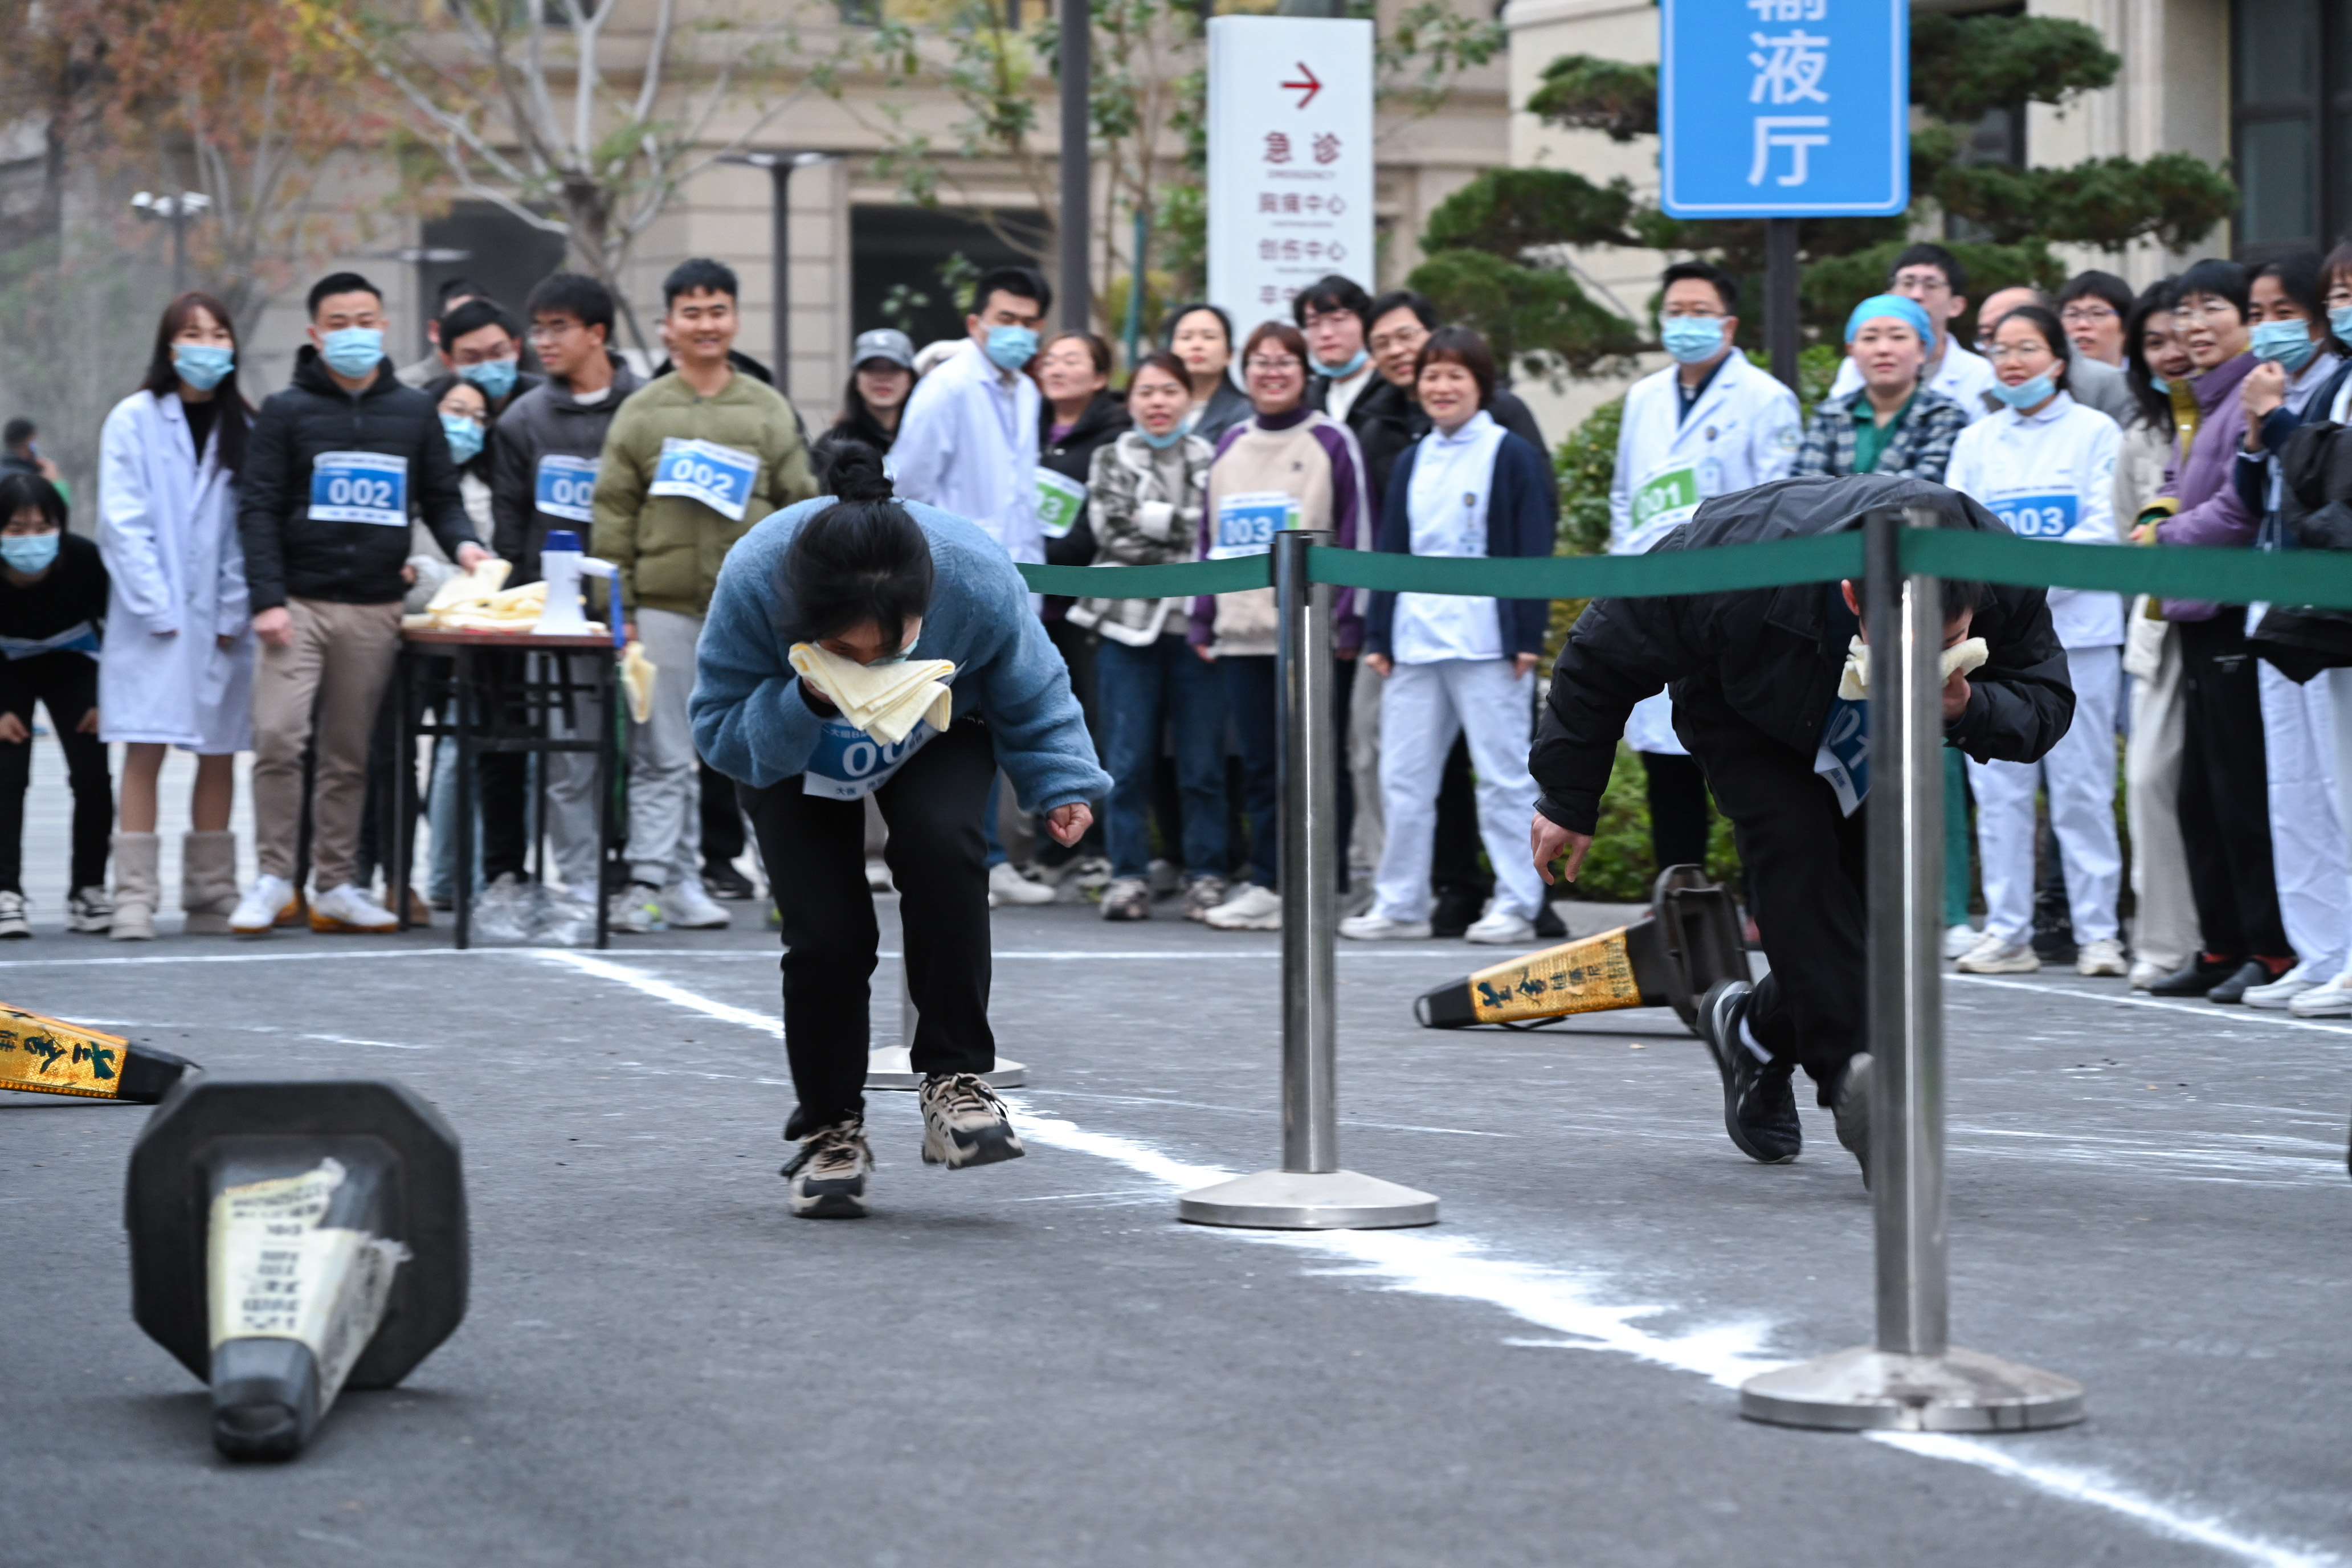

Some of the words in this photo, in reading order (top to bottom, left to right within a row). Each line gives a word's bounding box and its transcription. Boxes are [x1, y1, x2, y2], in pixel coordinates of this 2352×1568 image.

[1263, 130, 1342, 164] 急诊
[328, 477, 392, 508] 002
[671, 458, 735, 499] 002
[1998, 506, 2065, 535] 003
